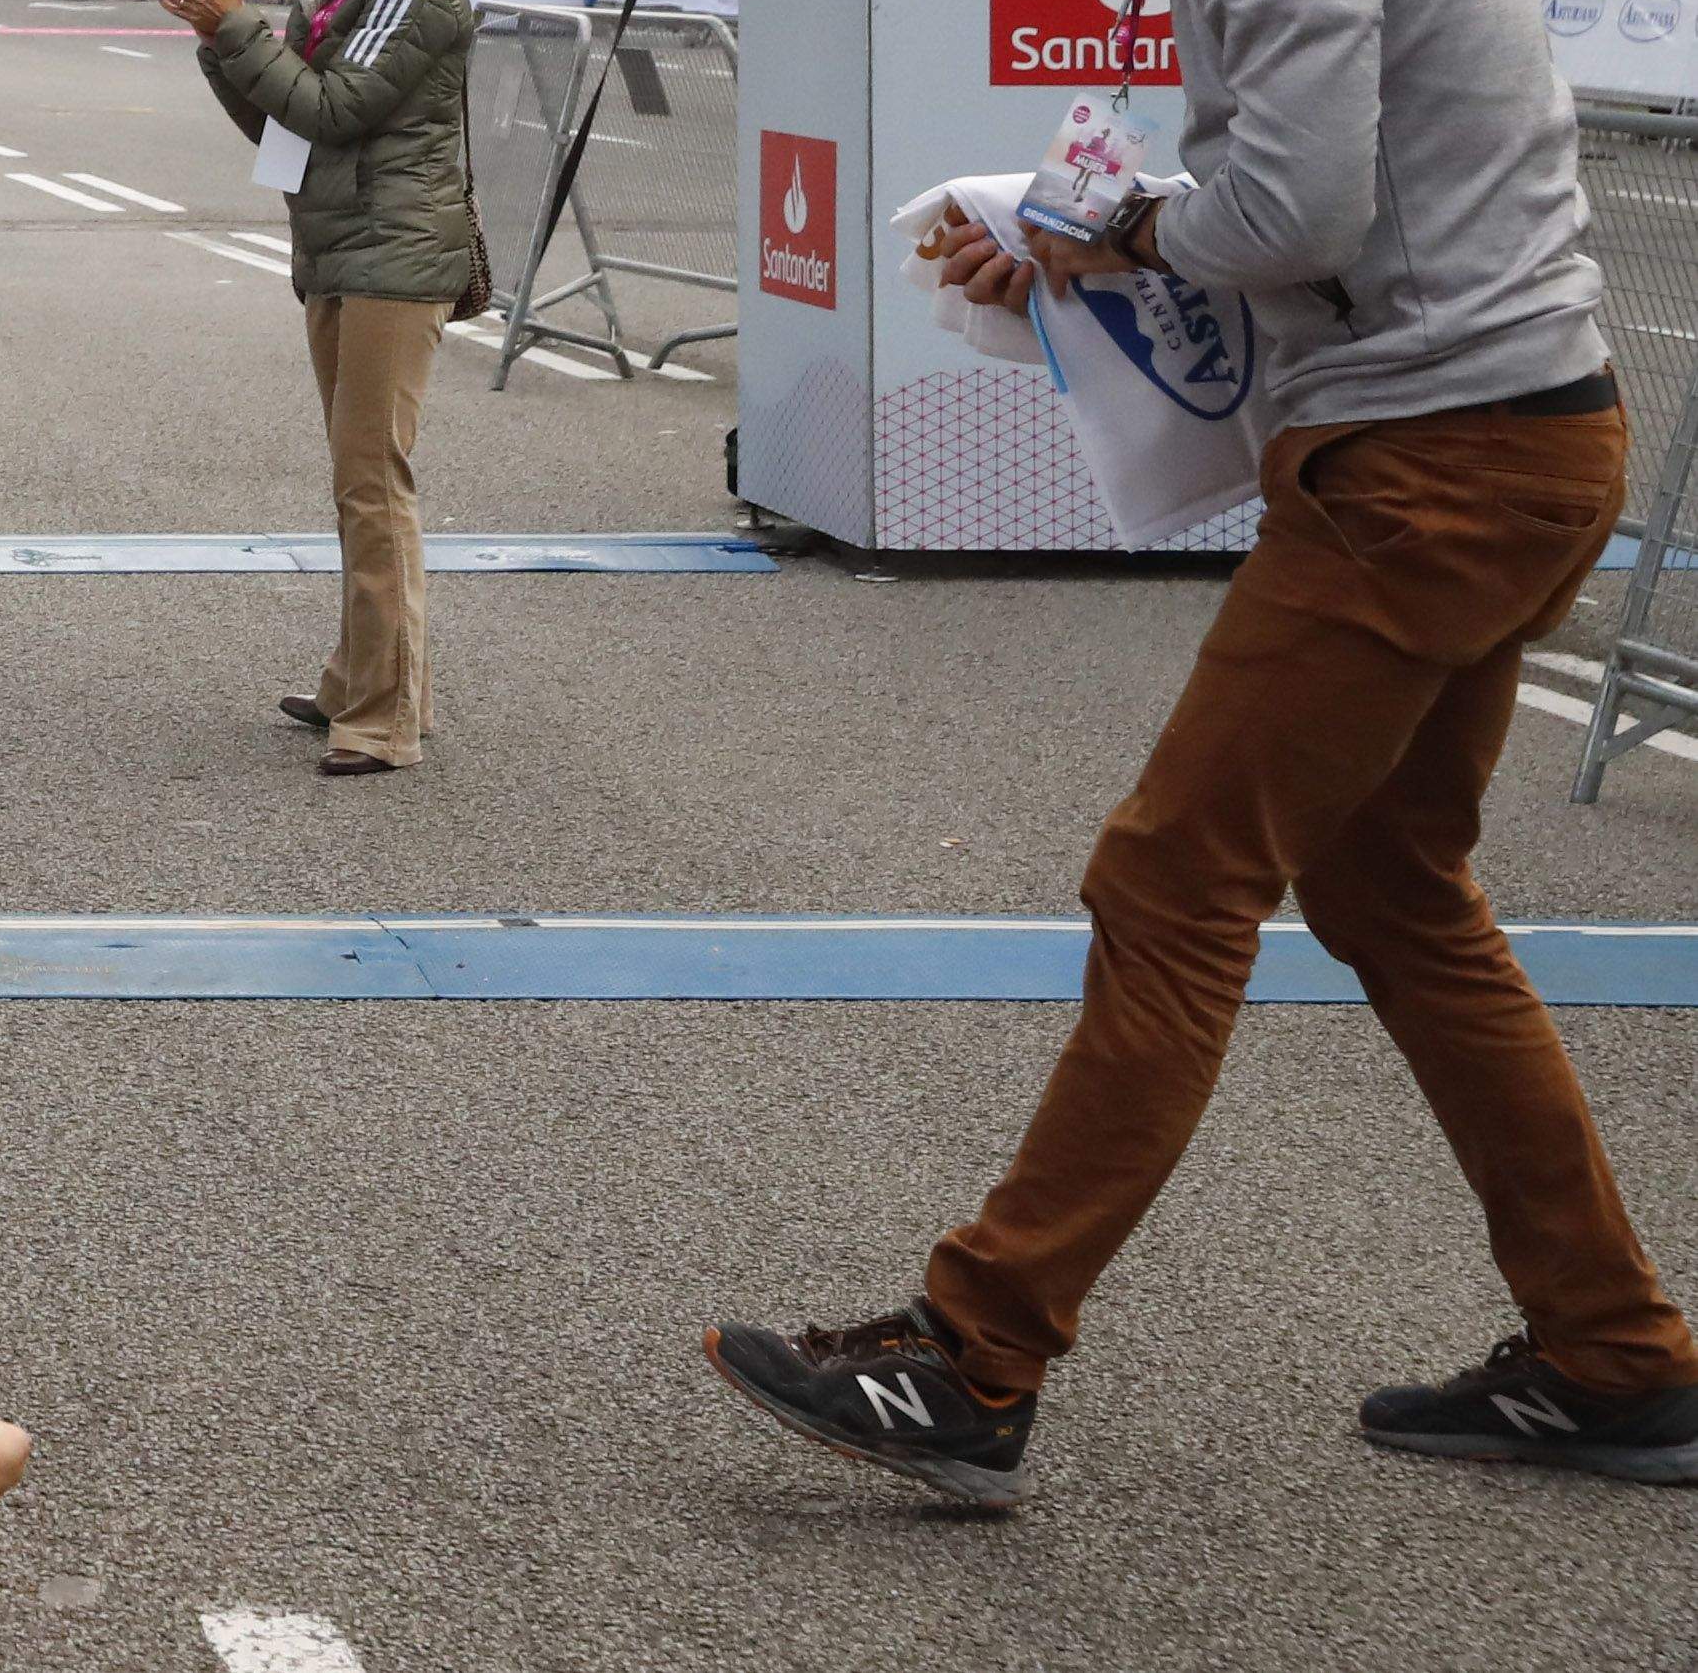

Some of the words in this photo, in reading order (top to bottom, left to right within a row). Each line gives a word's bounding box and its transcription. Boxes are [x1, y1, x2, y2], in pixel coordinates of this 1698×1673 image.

[1022, 207, 1092, 243] ORGANIZACIÓN
[762, 235, 830, 293] Santander
[855, 1371, 935, 1429] N
[1487, 1386, 1580, 1436] N
